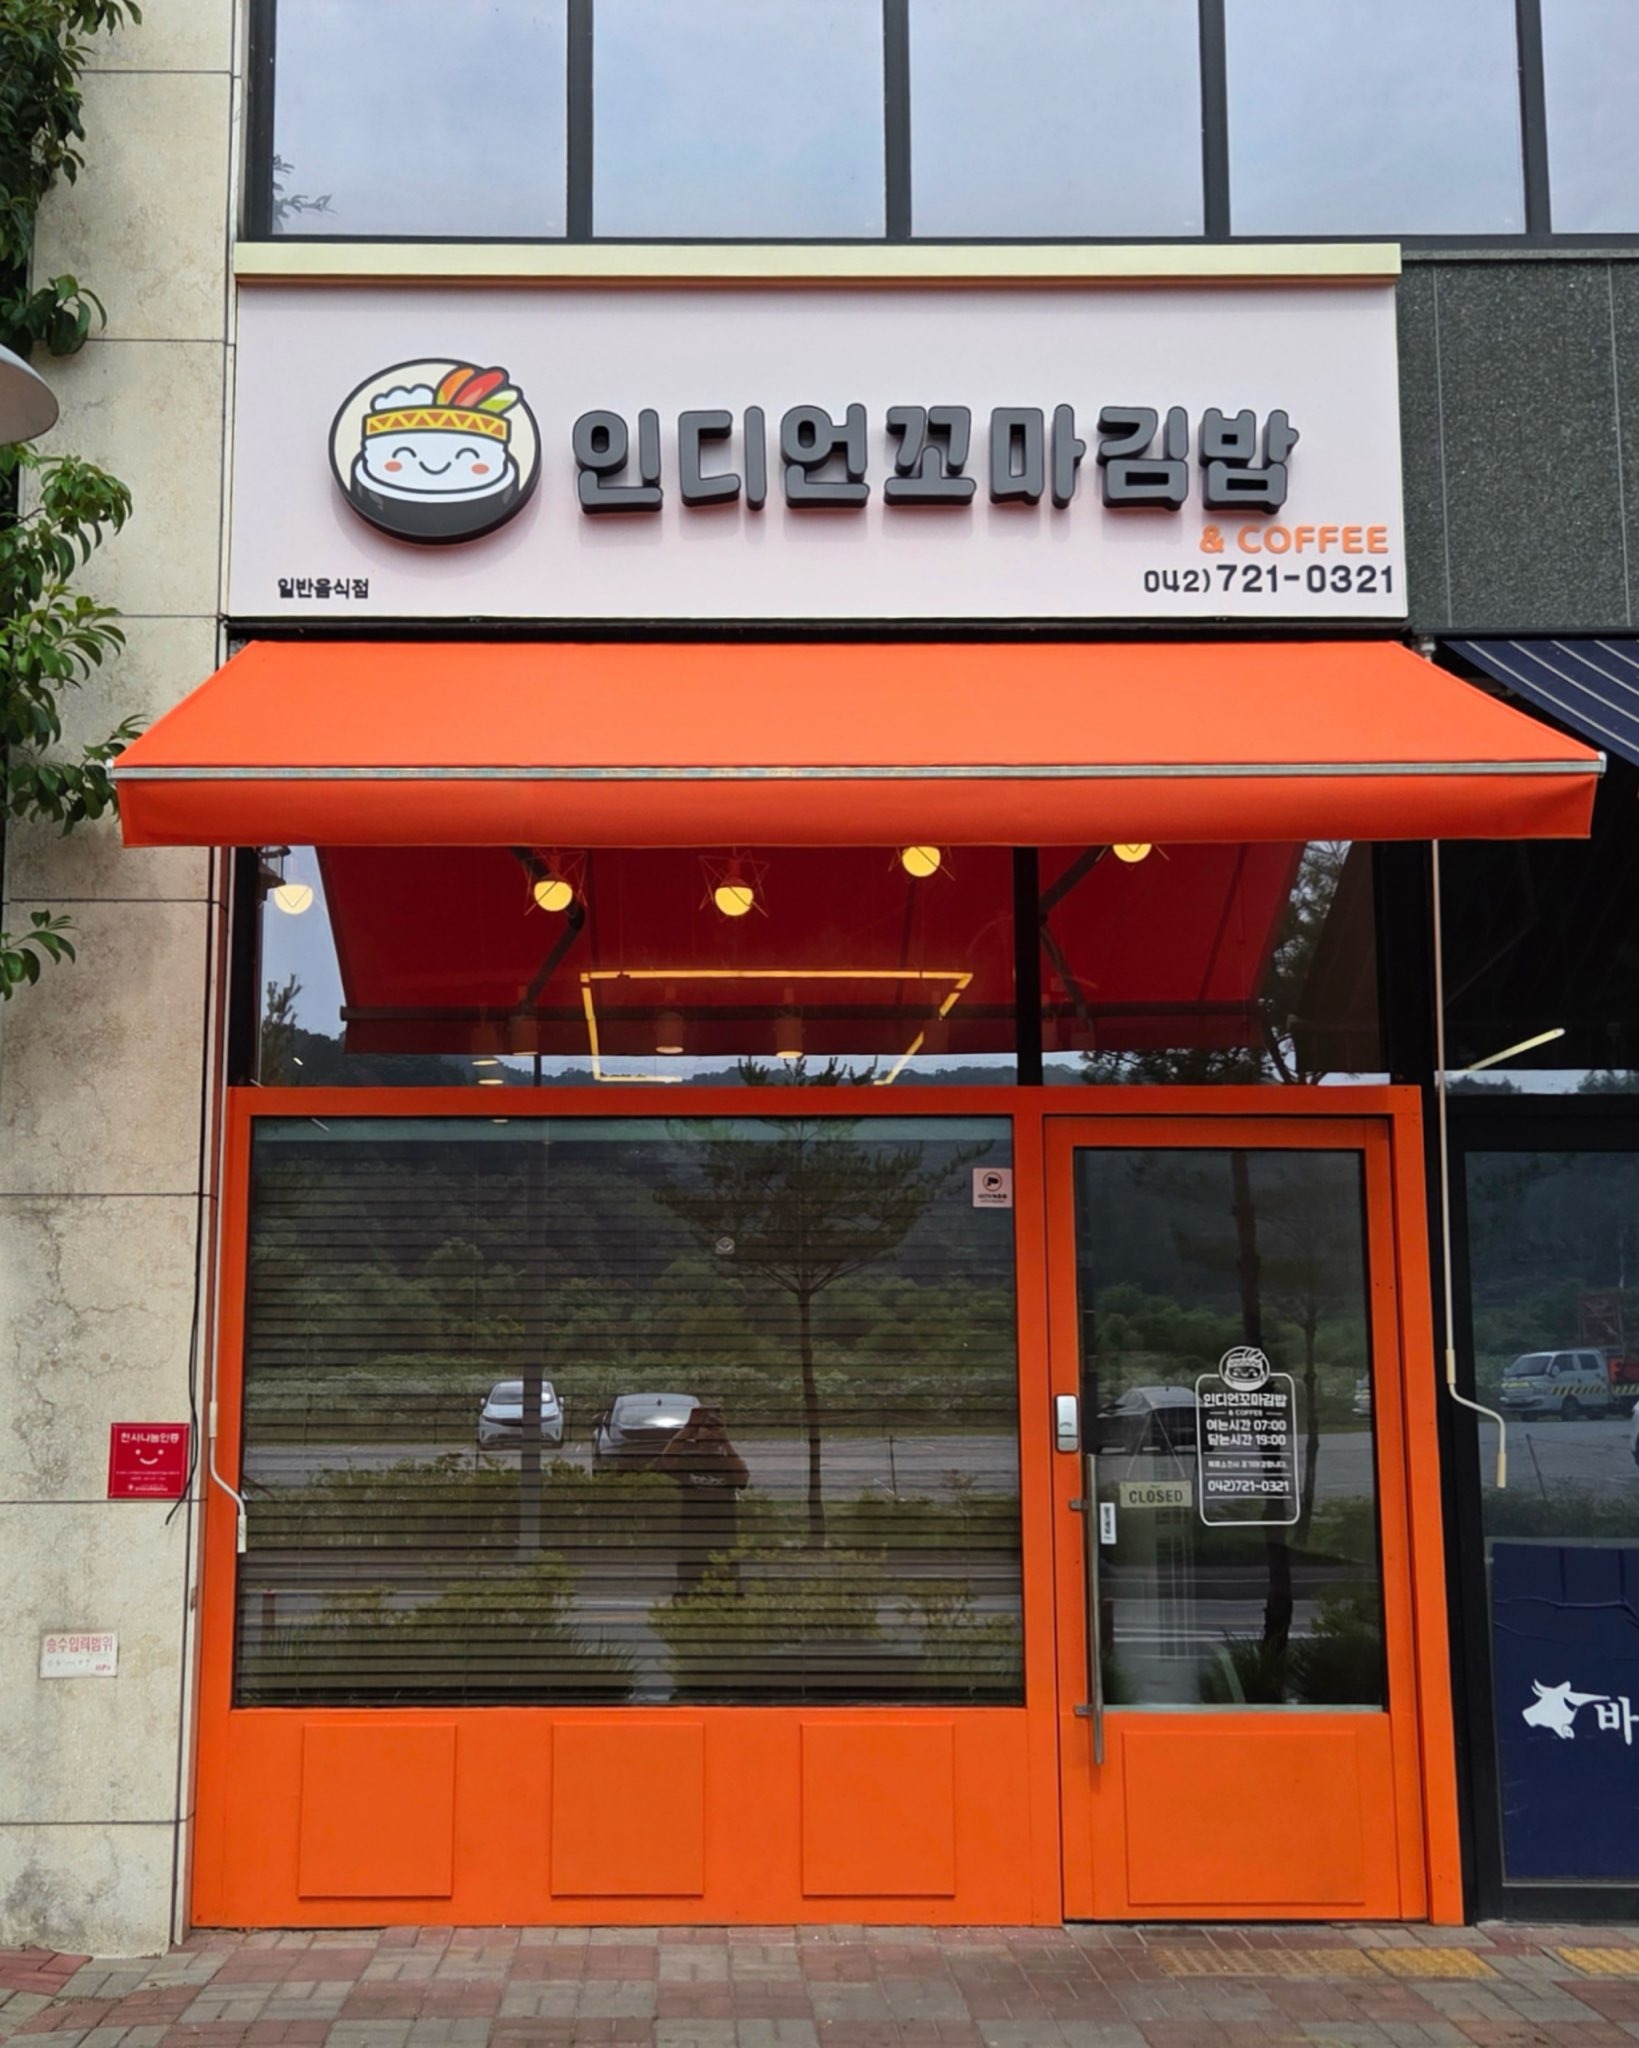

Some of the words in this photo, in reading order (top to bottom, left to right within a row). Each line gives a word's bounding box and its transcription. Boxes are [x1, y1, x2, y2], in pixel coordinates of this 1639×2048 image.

[572, 403, 1300, 514] 인디언꼬마김밥
[1199, 525, 1225, 554] &
[1237, 525, 1388, 554] COFFEE
[1143, 564, 1393, 594] 042)721-0321
[277, 577, 369, 599] 일반음식점
[1203, 1393, 1287, 1408] 인디언꼬마김밥
[1206, 1419, 1251, 1431] 여는시간
[1253, 1419, 1287, 1431] 07:00
[1207, 1434, 1252, 1446] 닫는시간
[1255, 1434, 1287, 1446] 19:00
[1207, 1479, 1289, 1493] 042)721-0321
[1128, 1489, 1183, 1504] CLOSED
